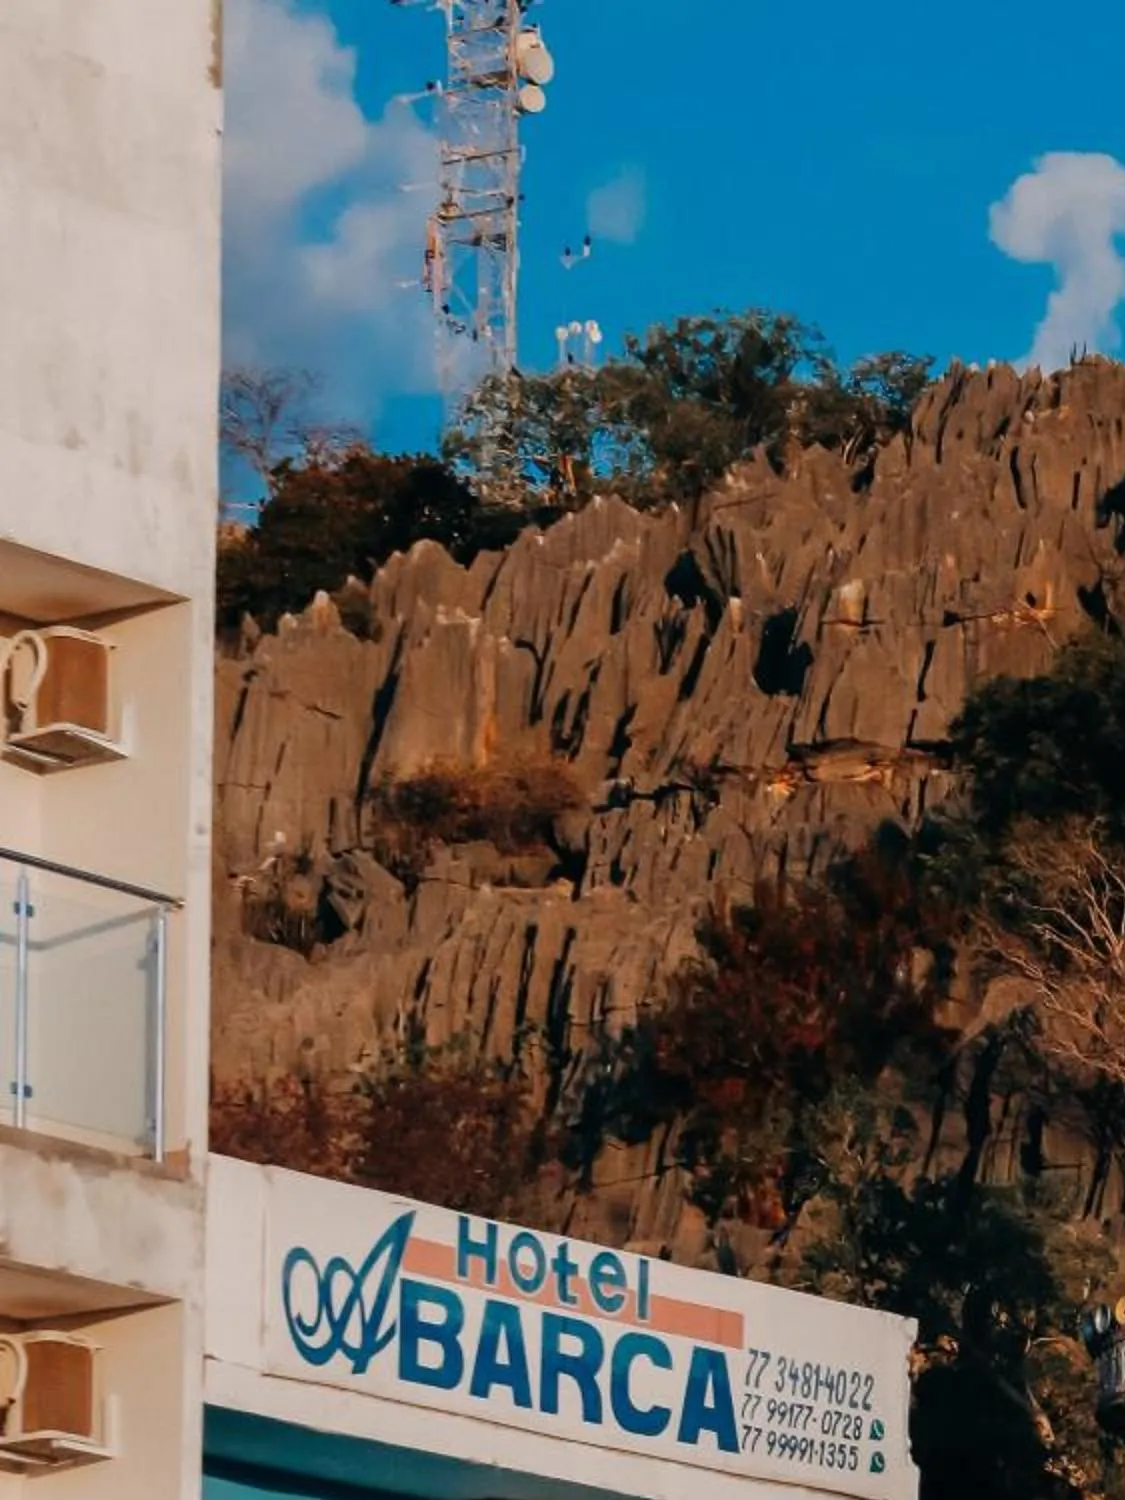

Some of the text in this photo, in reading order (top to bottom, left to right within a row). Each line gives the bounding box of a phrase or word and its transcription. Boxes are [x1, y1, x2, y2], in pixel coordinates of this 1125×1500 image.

[457, 1215, 652, 1321] Hotel
[741, 1393, 762, 1420] 77
[744, 1347, 875, 1412] 77 3481-4022
[741, 1425, 859, 1471] 77 99991-1355
